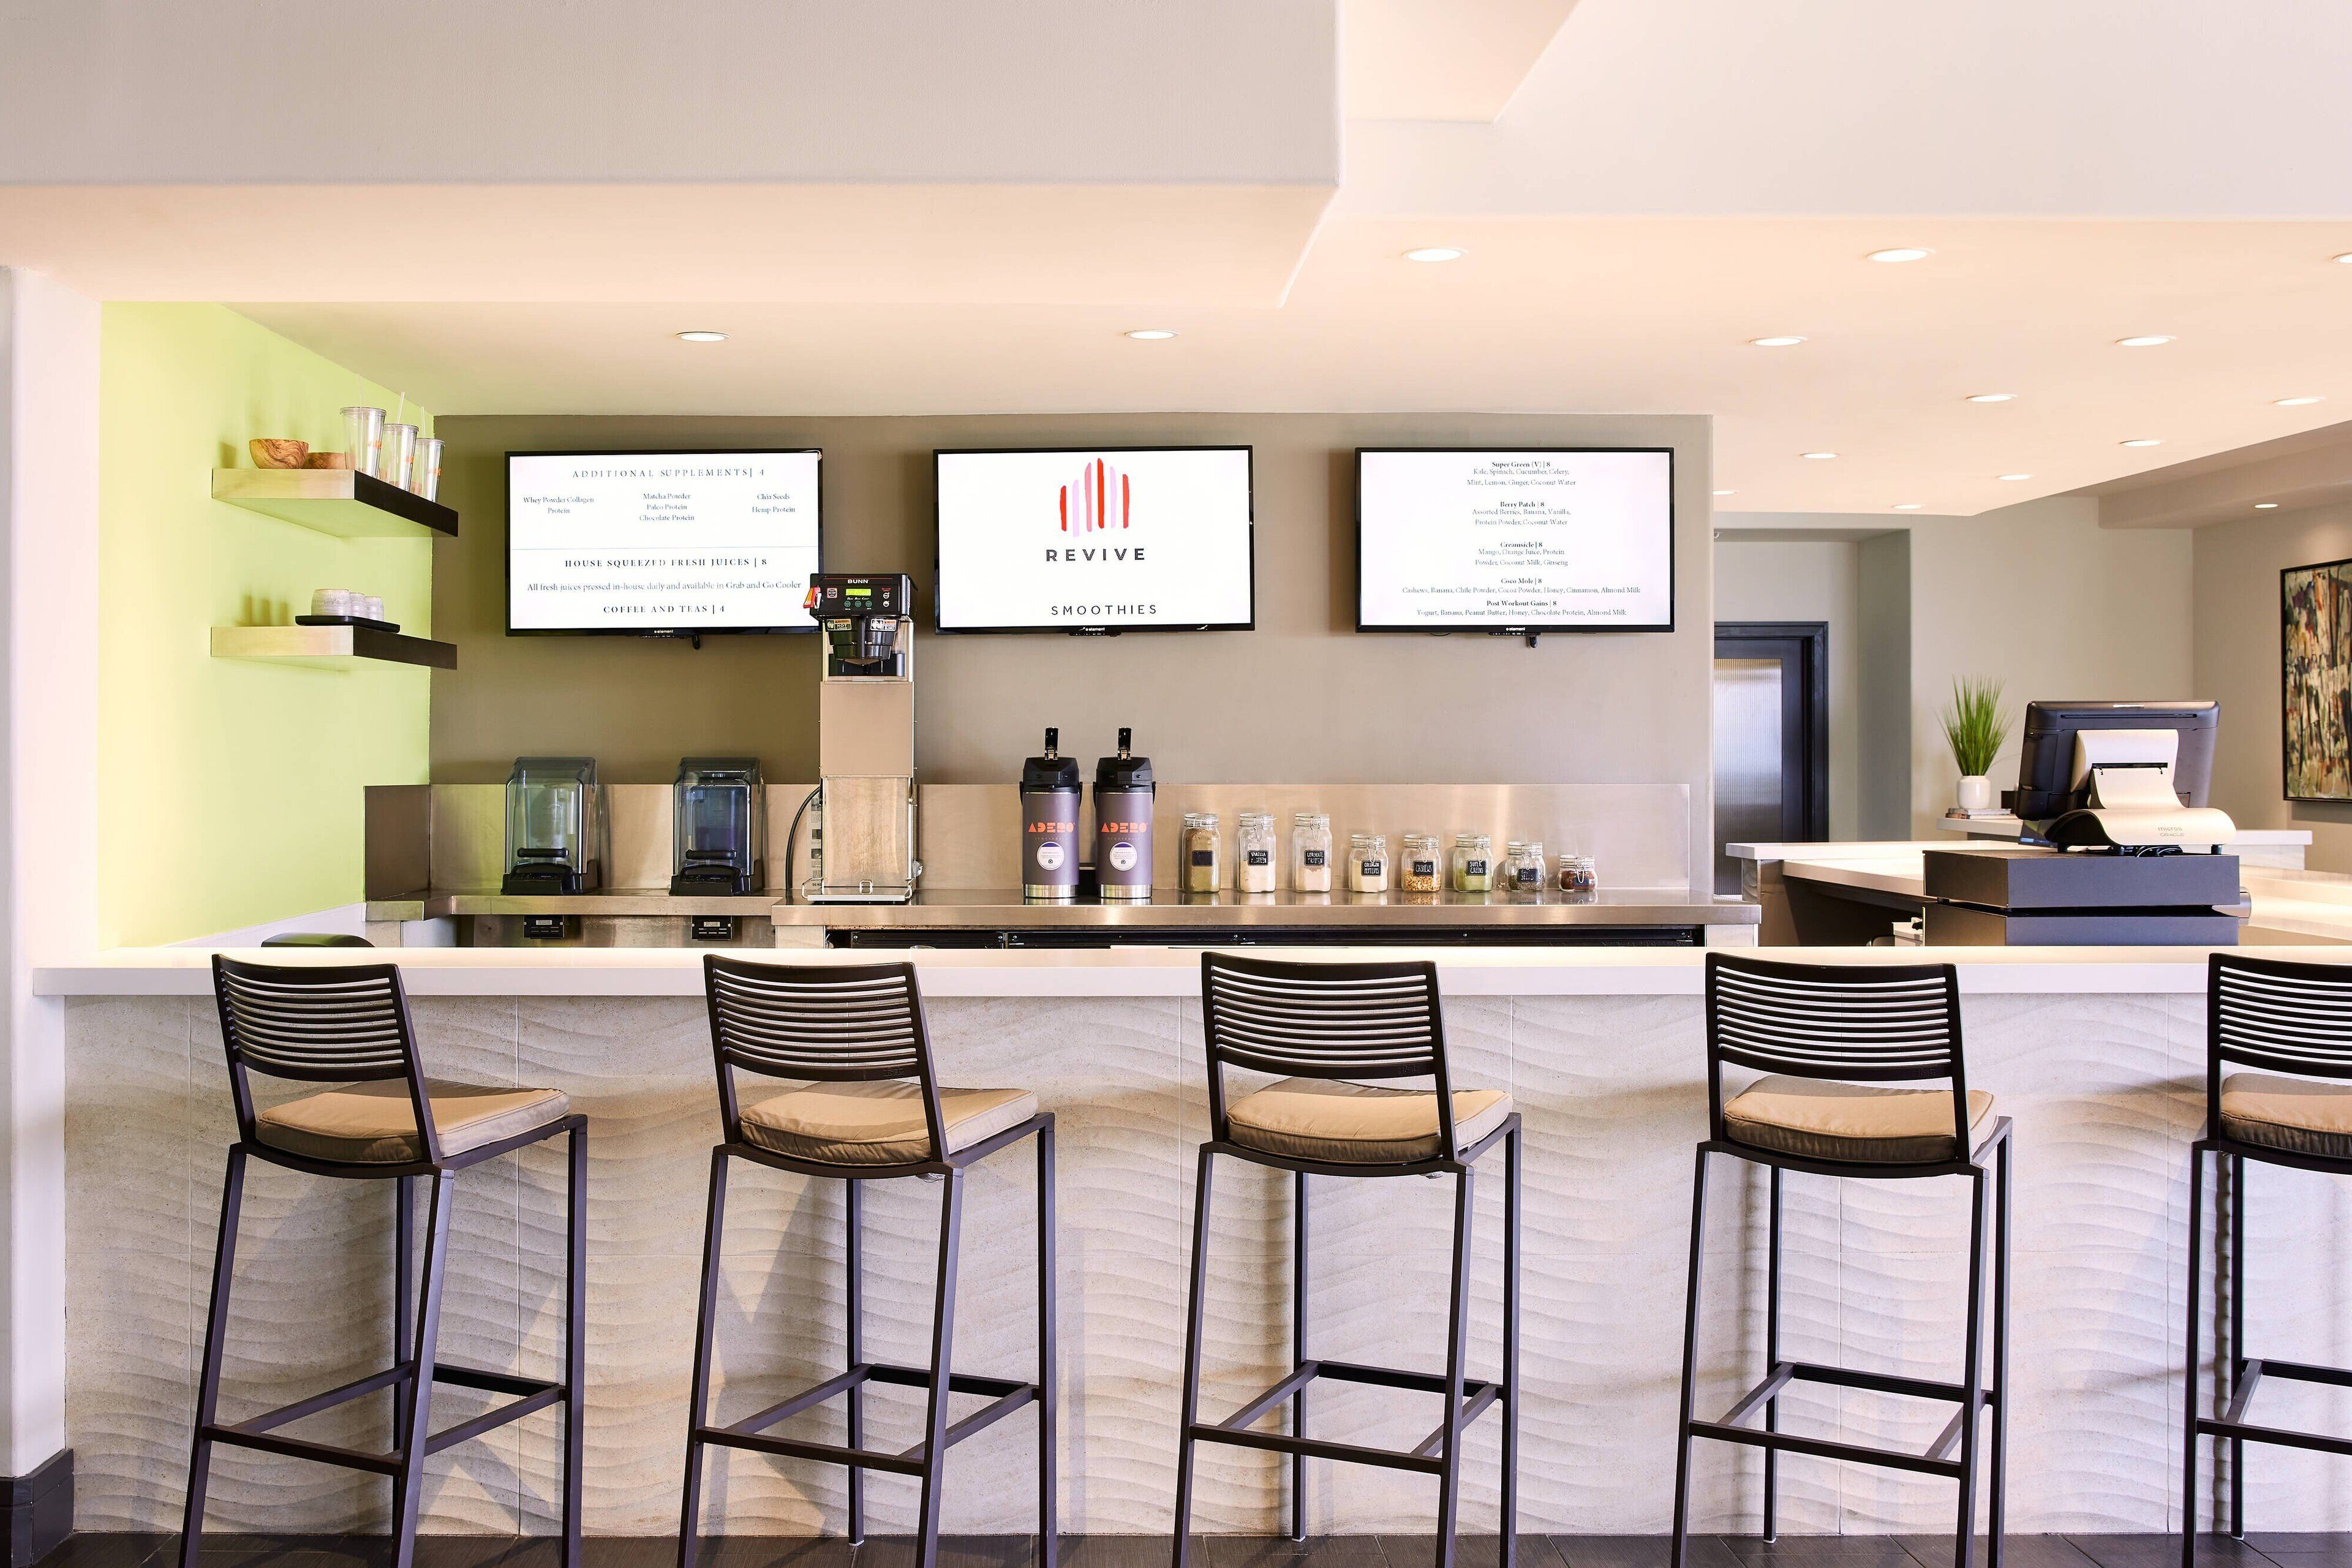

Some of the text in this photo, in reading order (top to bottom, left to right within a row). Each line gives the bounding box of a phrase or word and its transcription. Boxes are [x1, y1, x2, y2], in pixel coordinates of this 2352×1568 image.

[1046, 548, 1144, 561] REVIVE
[560, 584, 581, 592] juices
[583, 584, 611, 592] pressed
[647, 582, 665, 591] daily
[1052, 605, 1156, 616] SMOOTHIES
[1028, 822, 1074, 833] ADERO
[1101, 822, 1147, 833] ADERO
